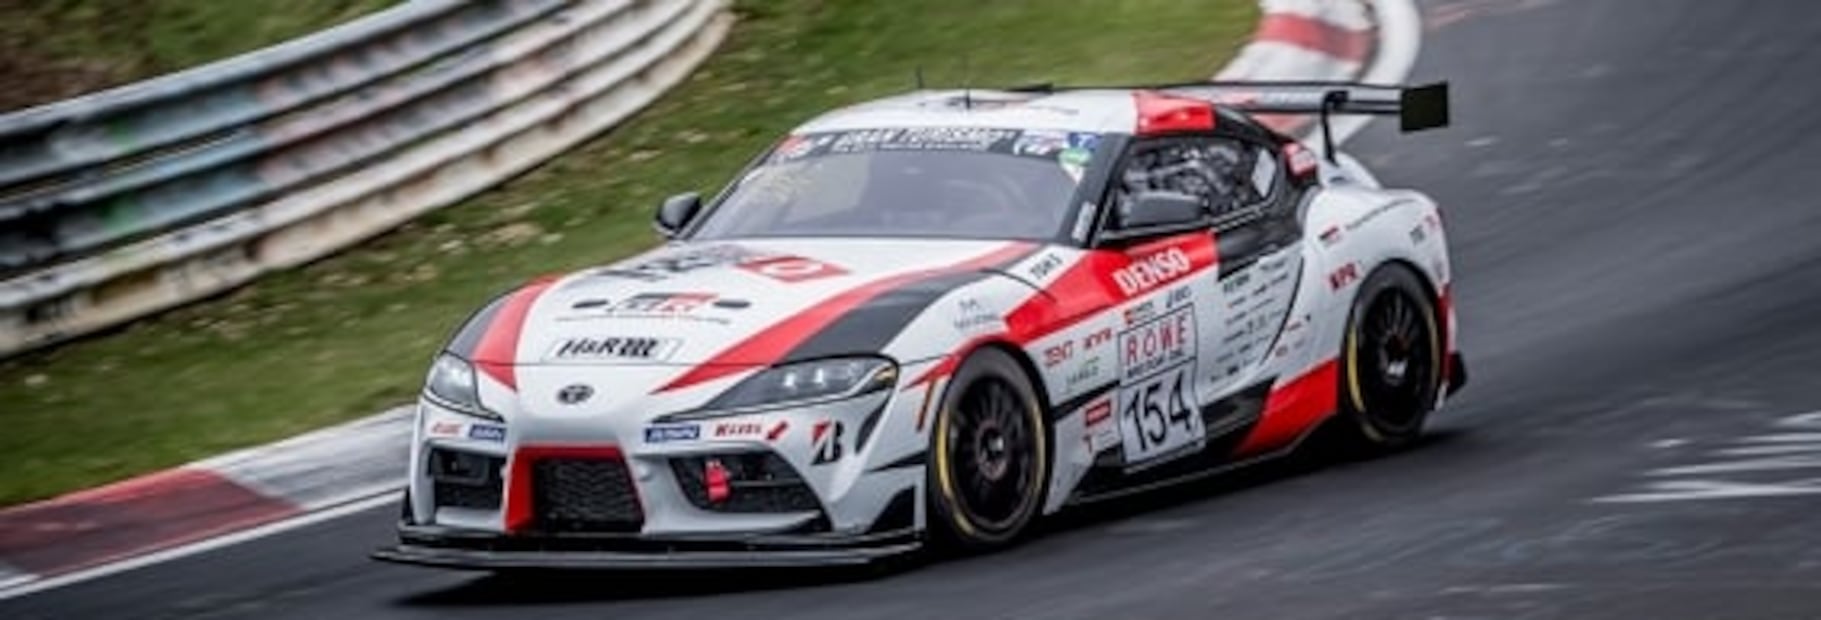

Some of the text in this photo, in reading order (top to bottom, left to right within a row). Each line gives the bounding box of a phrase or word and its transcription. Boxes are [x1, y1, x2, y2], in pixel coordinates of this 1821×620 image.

[1112, 247, 1191, 296] DENSO
[1126, 314, 1187, 366] ROWE
[1124, 370, 1191, 452] 154
